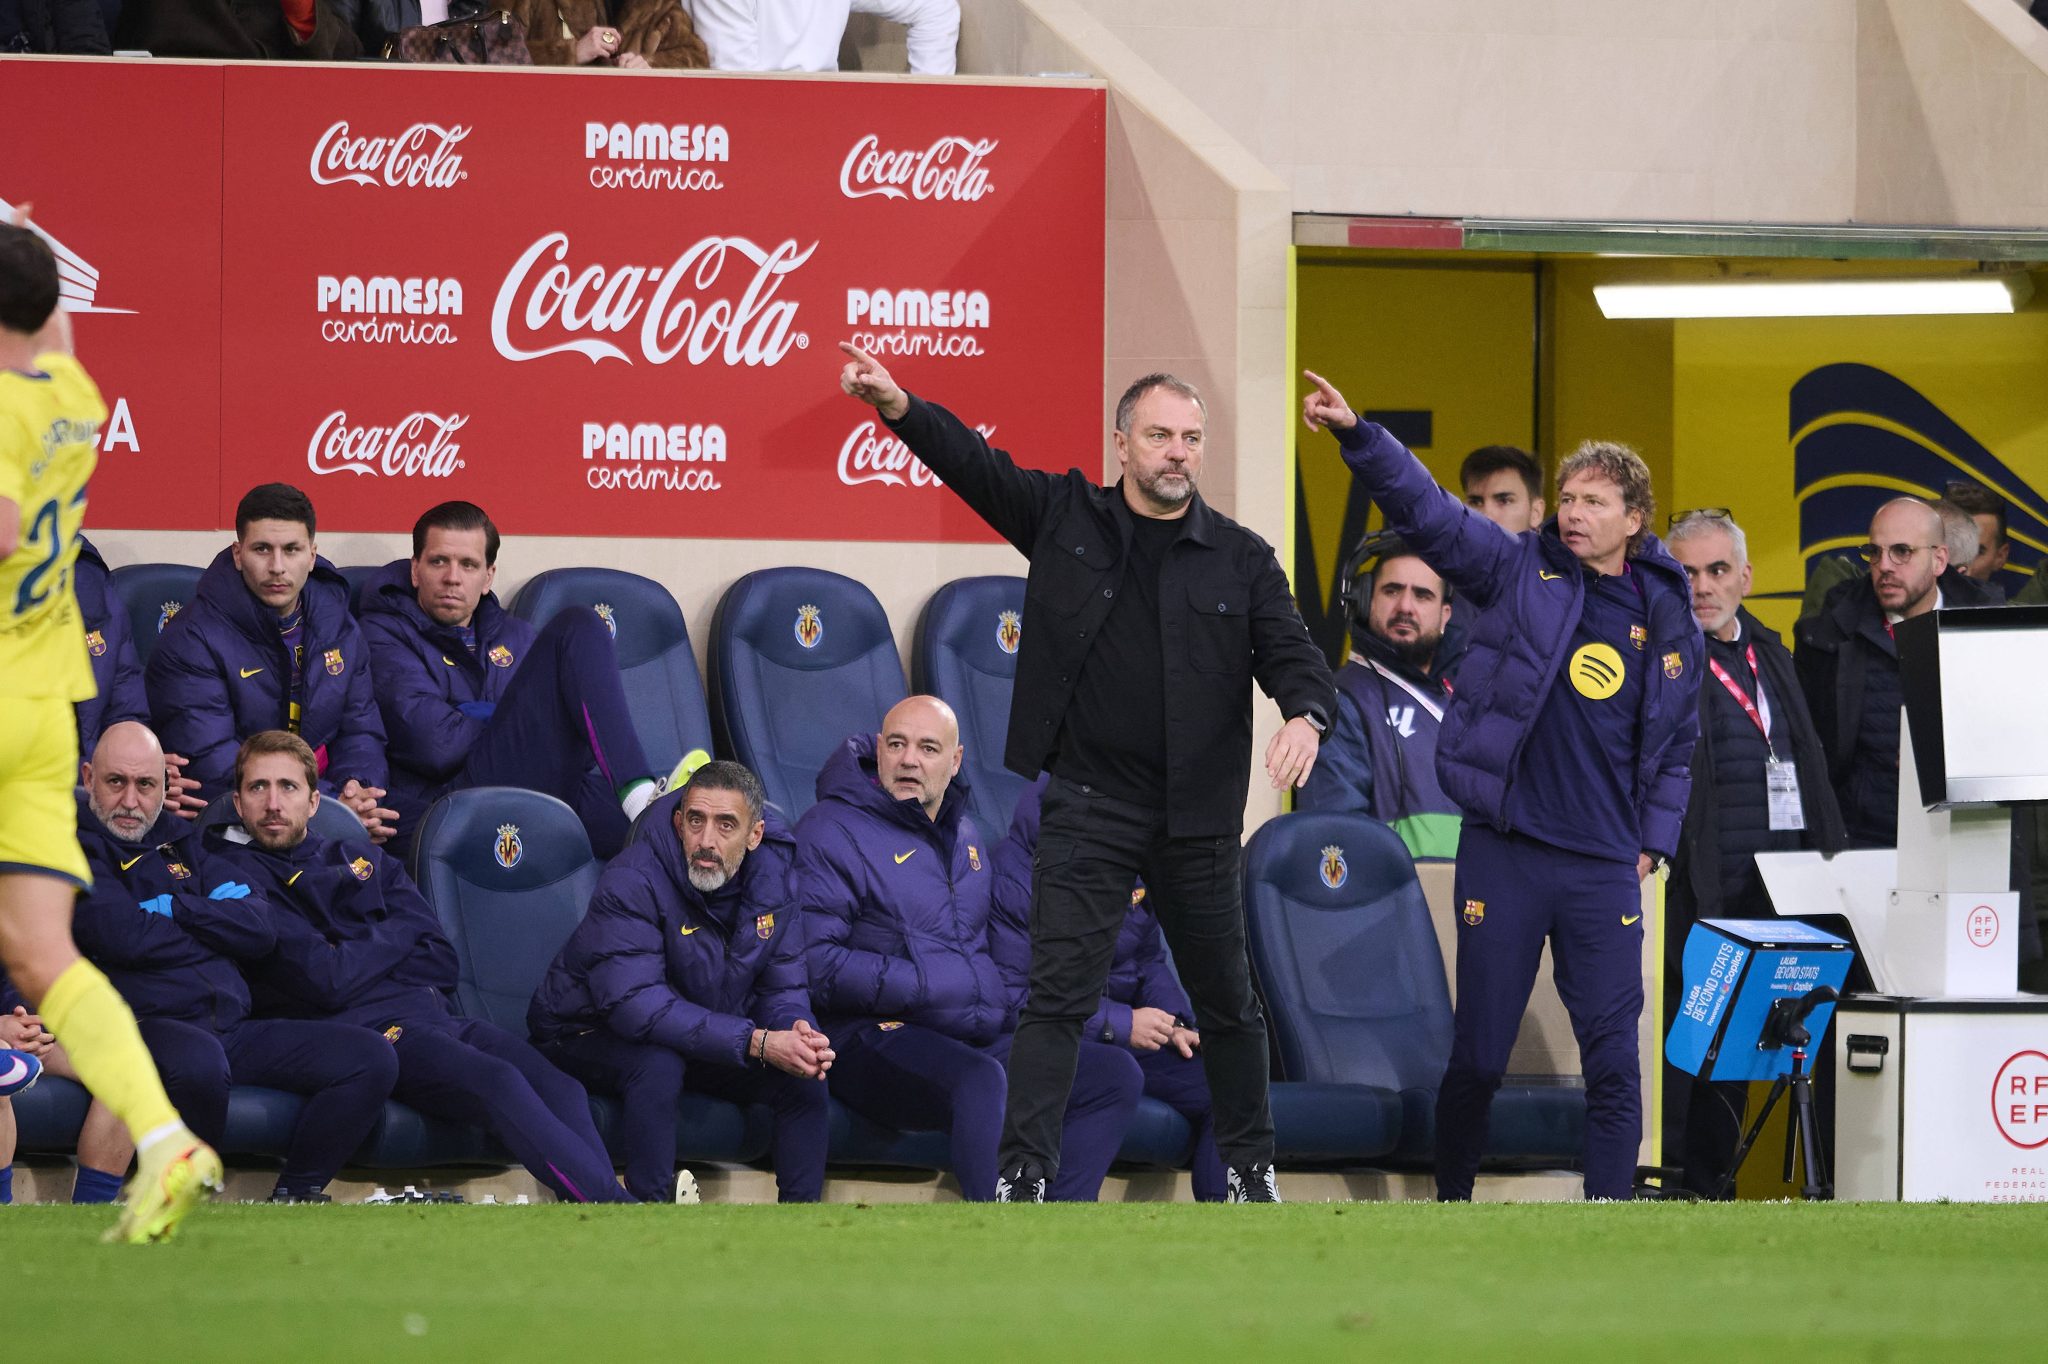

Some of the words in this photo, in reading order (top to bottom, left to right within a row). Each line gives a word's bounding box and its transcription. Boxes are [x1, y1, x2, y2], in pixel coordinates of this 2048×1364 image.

[310, 121, 472, 188] Coca-Cola
[585, 122, 729, 162] PAMESA
[589, 161, 724, 191] cerámica
[839, 134, 998, 202] Coca-Cola
[317, 275, 463, 315] PAMESA
[490, 232, 819, 367] Coca-Cola
[847, 288, 990, 328] PAMESA
[321, 315, 457, 345] cerámica
[851, 329, 985, 357] cerámica
[307, 410, 470, 478] Coca-Cola
[582, 422, 727, 462] PAMESA
[587, 461, 722, 492] cerámica
[1691, 977, 1719, 1022] BEYOND
[1710, 943, 1734, 979] STATS
[1724, 949, 1744, 984] Copilot
[2012, 1167, 2045, 1175] REAL
